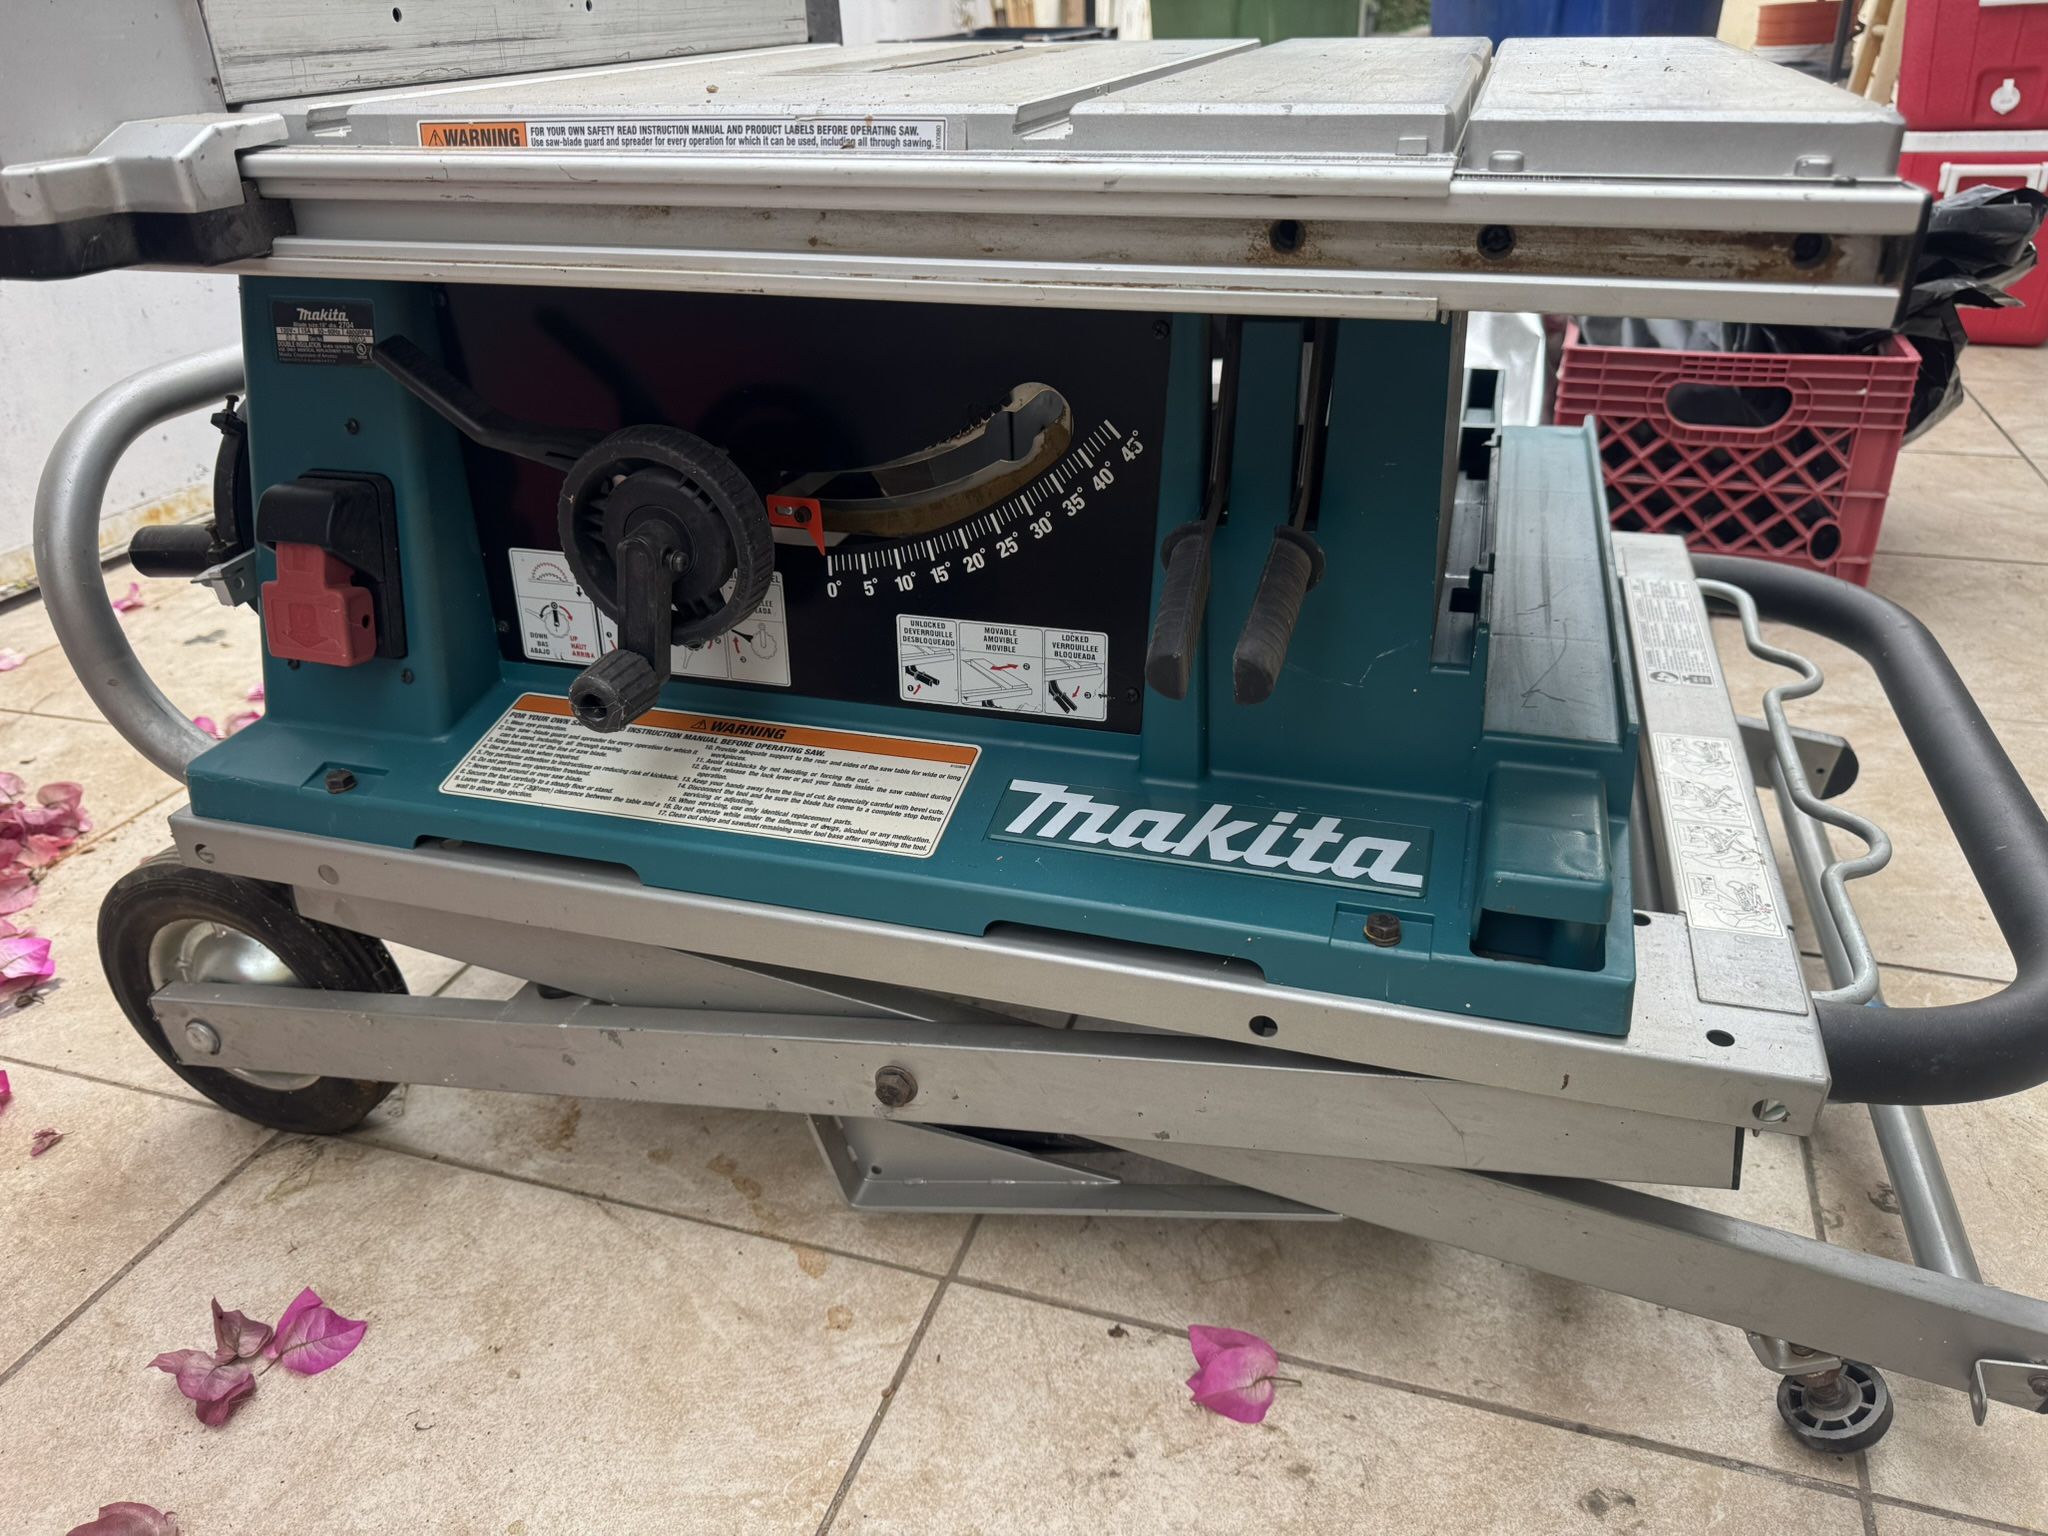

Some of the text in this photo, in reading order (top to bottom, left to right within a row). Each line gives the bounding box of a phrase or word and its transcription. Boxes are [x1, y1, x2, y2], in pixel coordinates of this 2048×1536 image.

[530, 124, 918, 136] FOR YOUR OWN SAFETY READ INSTRUCTION MANUAL AND PRODUCT LABELS BEFORE OPERATING SAW.
[444, 128, 520, 146] WARNING
[531, 136, 934, 149] Use saw-blade guard and spreader for every operation for which it can be used, including all through sawing.
[826, 430, 1144, 598] 0° 5° 10° 15° 20° 25° 30° 35° 40° 45°
[910, 620, 945, 629] UNLOCKED
[904, 628, 952, 638] DEVERROUILLE
[984, 627, 1016, 636] MOVABLE
[903, 636, 955, 646] DESBLOQUEADO
[984, 636, 1018, 645] AMOVIBLE
[1062, 634, 1089, 643] LOCKED
[986, 644, 1016, 653] MOVIBLE
[1054, 651, 1096, 660] BLOQUEADA
[711, 721, 785, 738] WARNING
[627, 727, 682, 738] INSTRUCTION
[682, 734, 717, 743] MANUAL
[720, 738, 754, 747] BEFORE
[755, 743, 802, 753] OPERATING
[820, 772, 842, 780] forcing
[837, 797, 868, 805] especially
[778, 818, 807, 826] influence
[791, 813, 831, 822] replacement
[759, 824, 792, 833] remaining
[861, 838, 898, 847] unplugging
